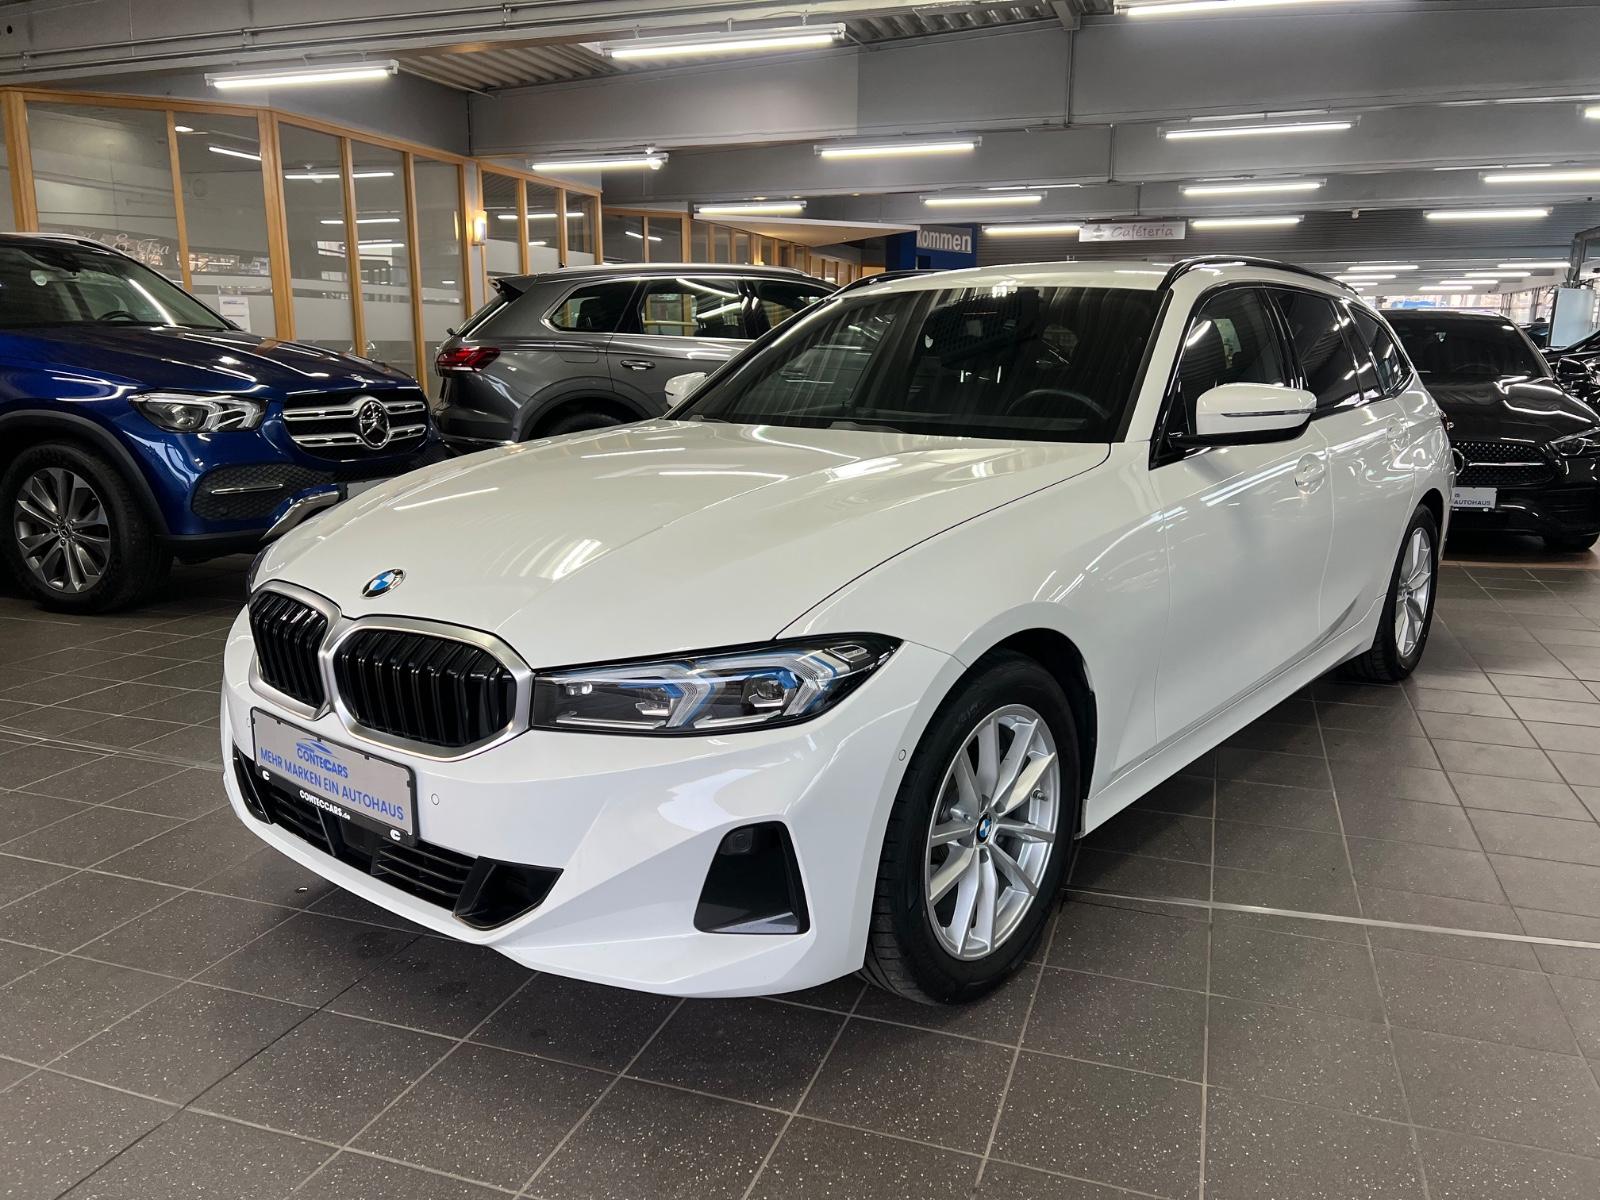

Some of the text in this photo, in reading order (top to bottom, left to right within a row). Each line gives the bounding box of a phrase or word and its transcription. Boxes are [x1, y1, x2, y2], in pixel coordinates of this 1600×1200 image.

[260, 747, 404, 820] MEHR MARKEN EIN AUTOHAUS
